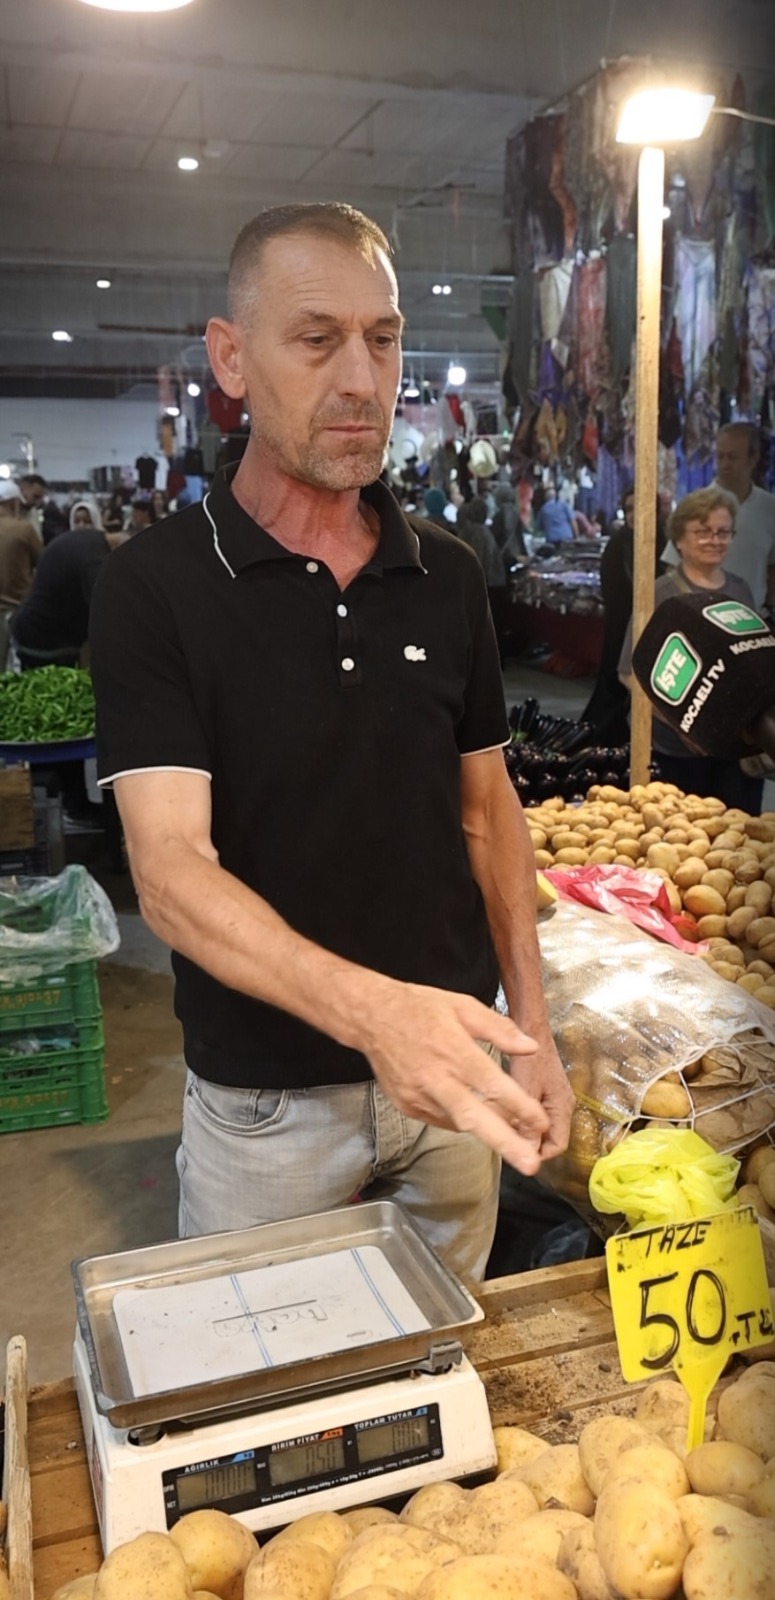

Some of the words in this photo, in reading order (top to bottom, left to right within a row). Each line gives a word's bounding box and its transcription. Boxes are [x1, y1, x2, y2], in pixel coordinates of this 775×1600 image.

[655, 648, 687, 692] İŞTE
[680, 677, 714, 733] KOCAELİ
[708, 658, 726, 680] TV
[629, 1221, 712, 1258] TAZE
[354, 1418, 386, 1431] TOPLAM
[387, 1411, 413, 1422] TUTAR
[271, 1440, 296, 1452] BİRİM
[296, 1433, 320, 1445] FİYAT
